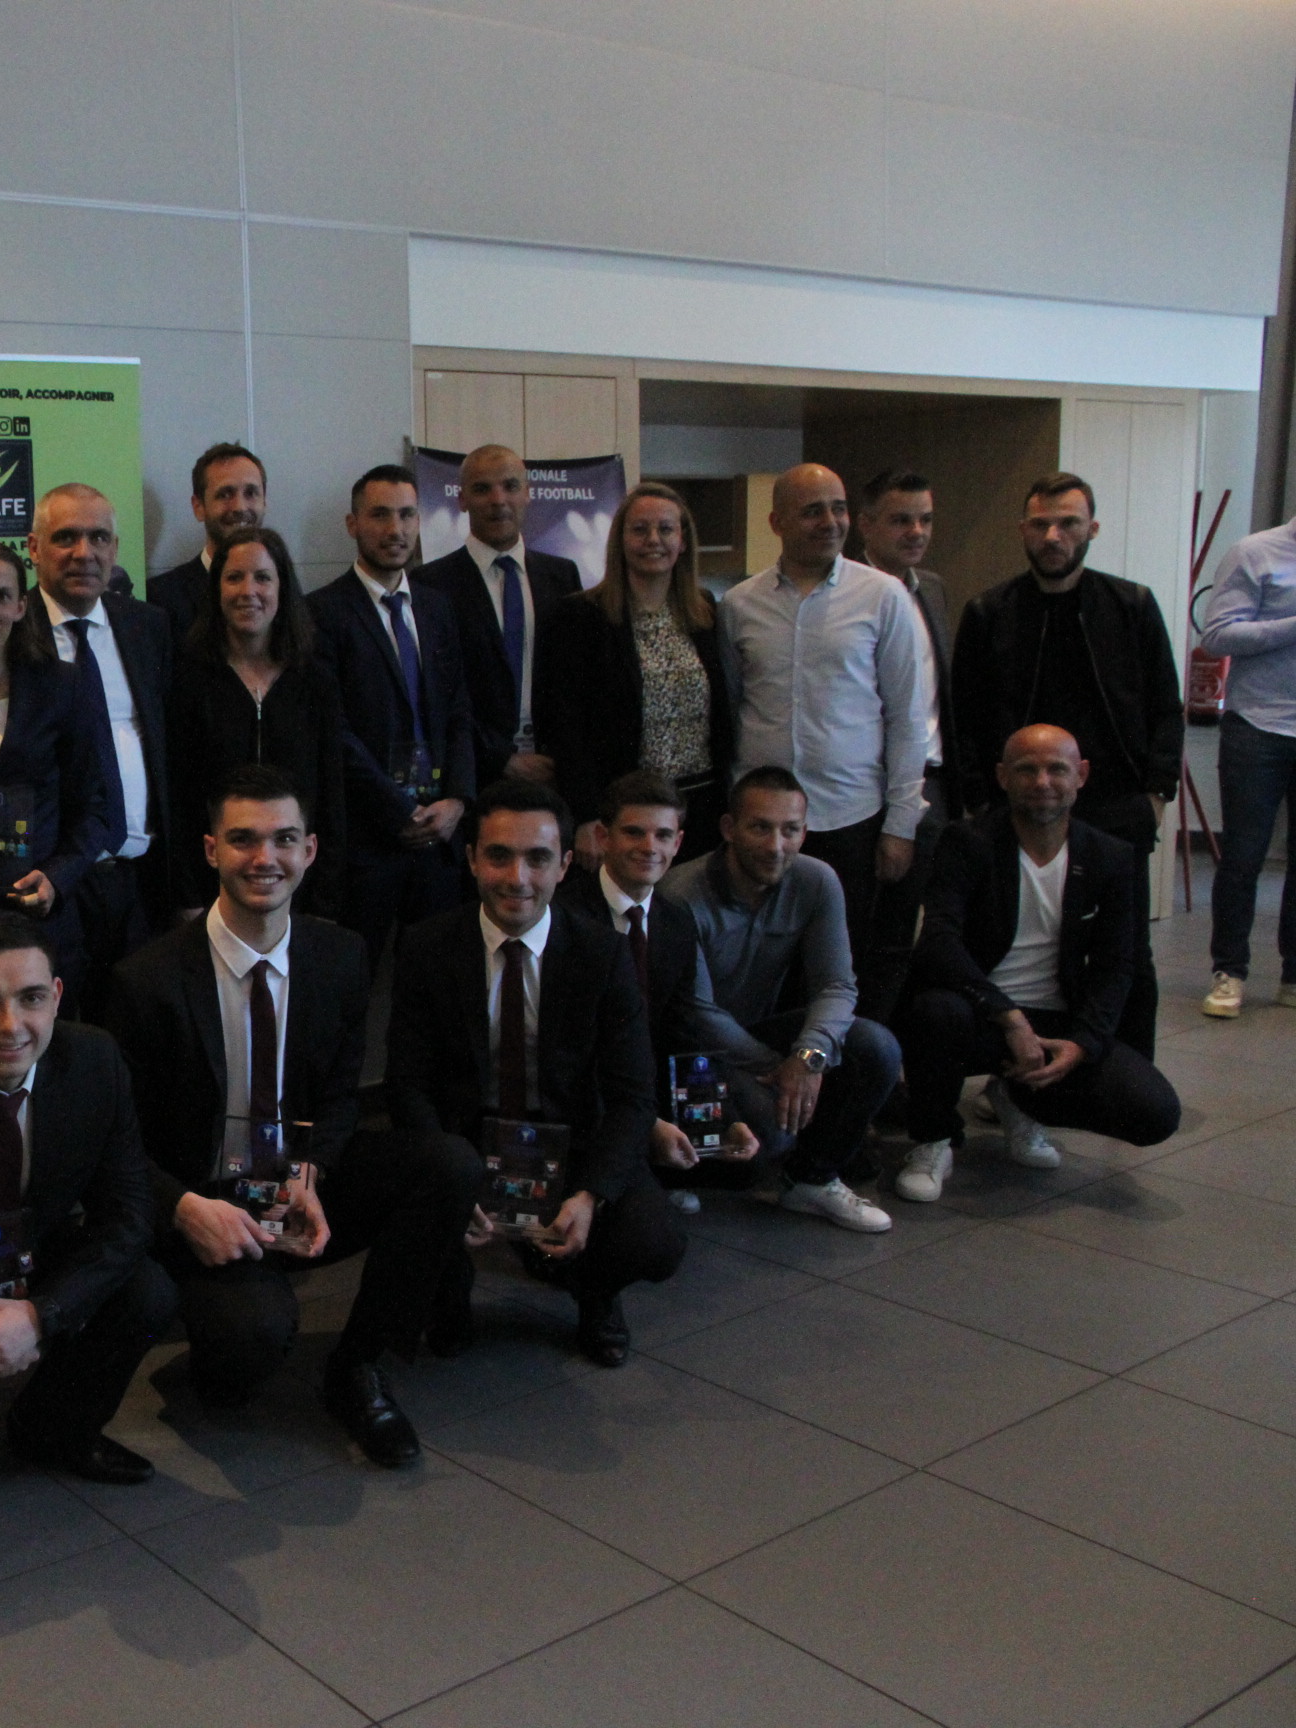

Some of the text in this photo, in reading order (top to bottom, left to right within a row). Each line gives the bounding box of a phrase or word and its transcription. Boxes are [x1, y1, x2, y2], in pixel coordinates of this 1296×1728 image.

[26, 390, 114, 401] ACCOMPAGNER
[527, 469, 568, 482] IONALE
[444, 484, 462, 497] DE
[537, 487, 595, 500] FOOTBALL
